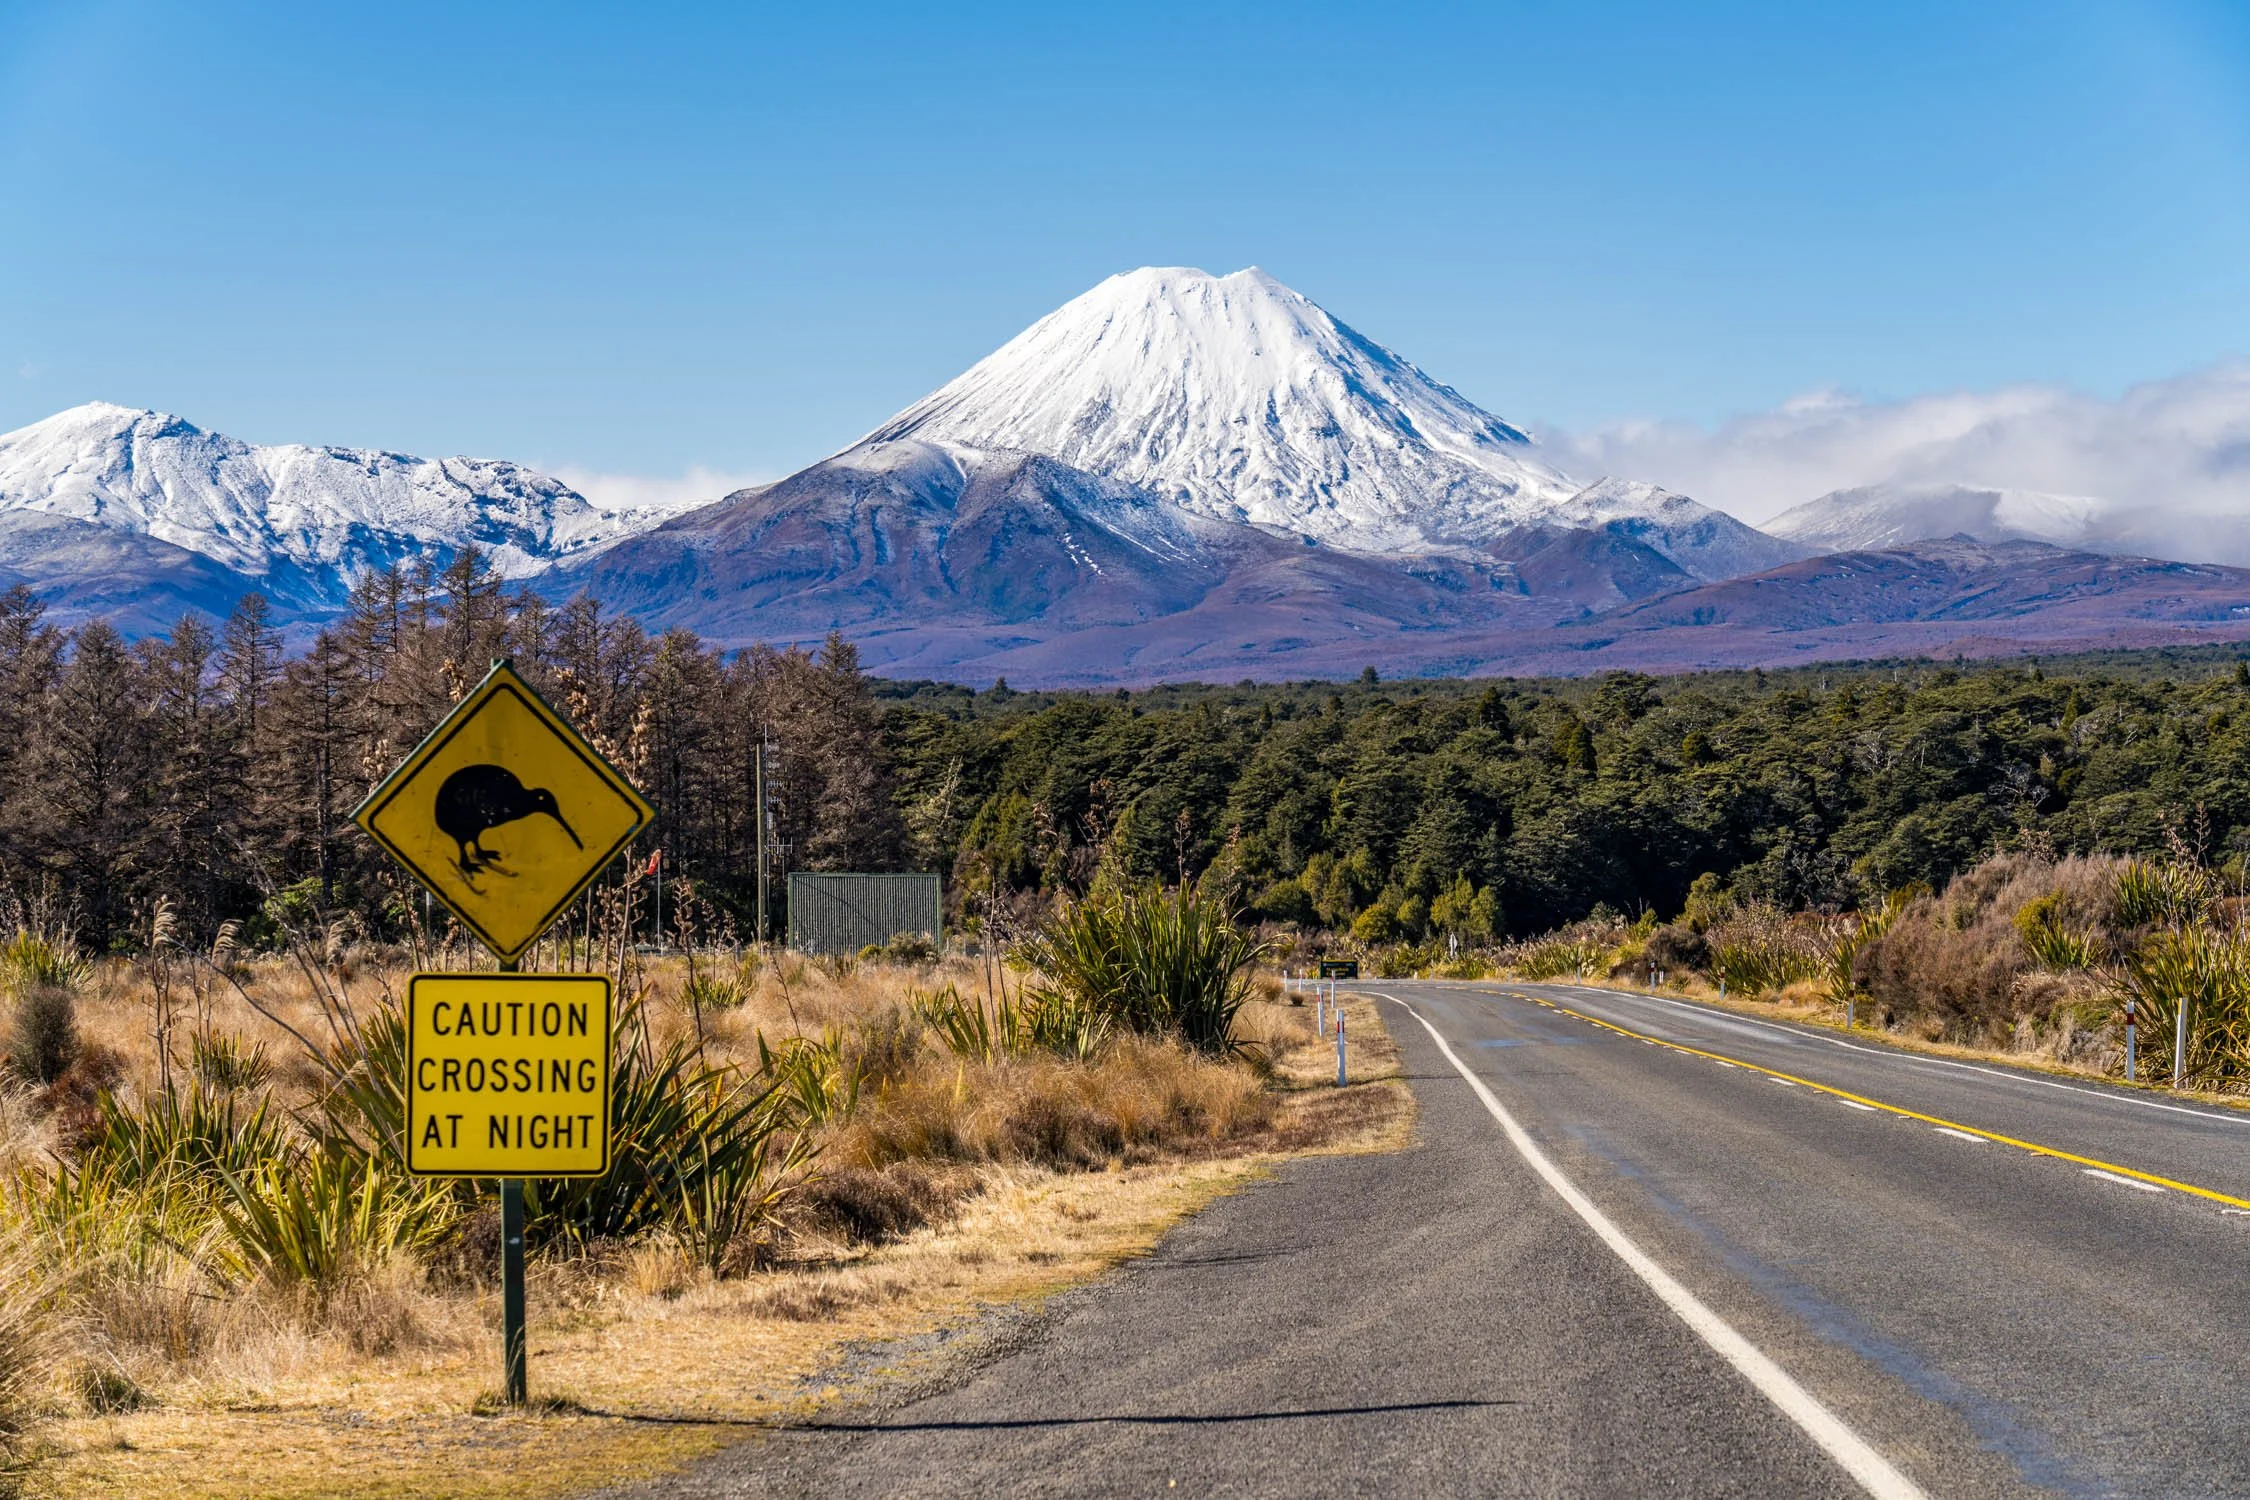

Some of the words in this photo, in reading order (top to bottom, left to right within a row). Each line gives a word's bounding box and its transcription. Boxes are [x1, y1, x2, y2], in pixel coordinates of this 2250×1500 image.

[432, 1002, 588, 1037] CAUTION
[417, 1058, 597, 1093] CROSSING
[421, 1115, 464, 1149] AT
[488, 1115, 595, 1149] NIGHT
